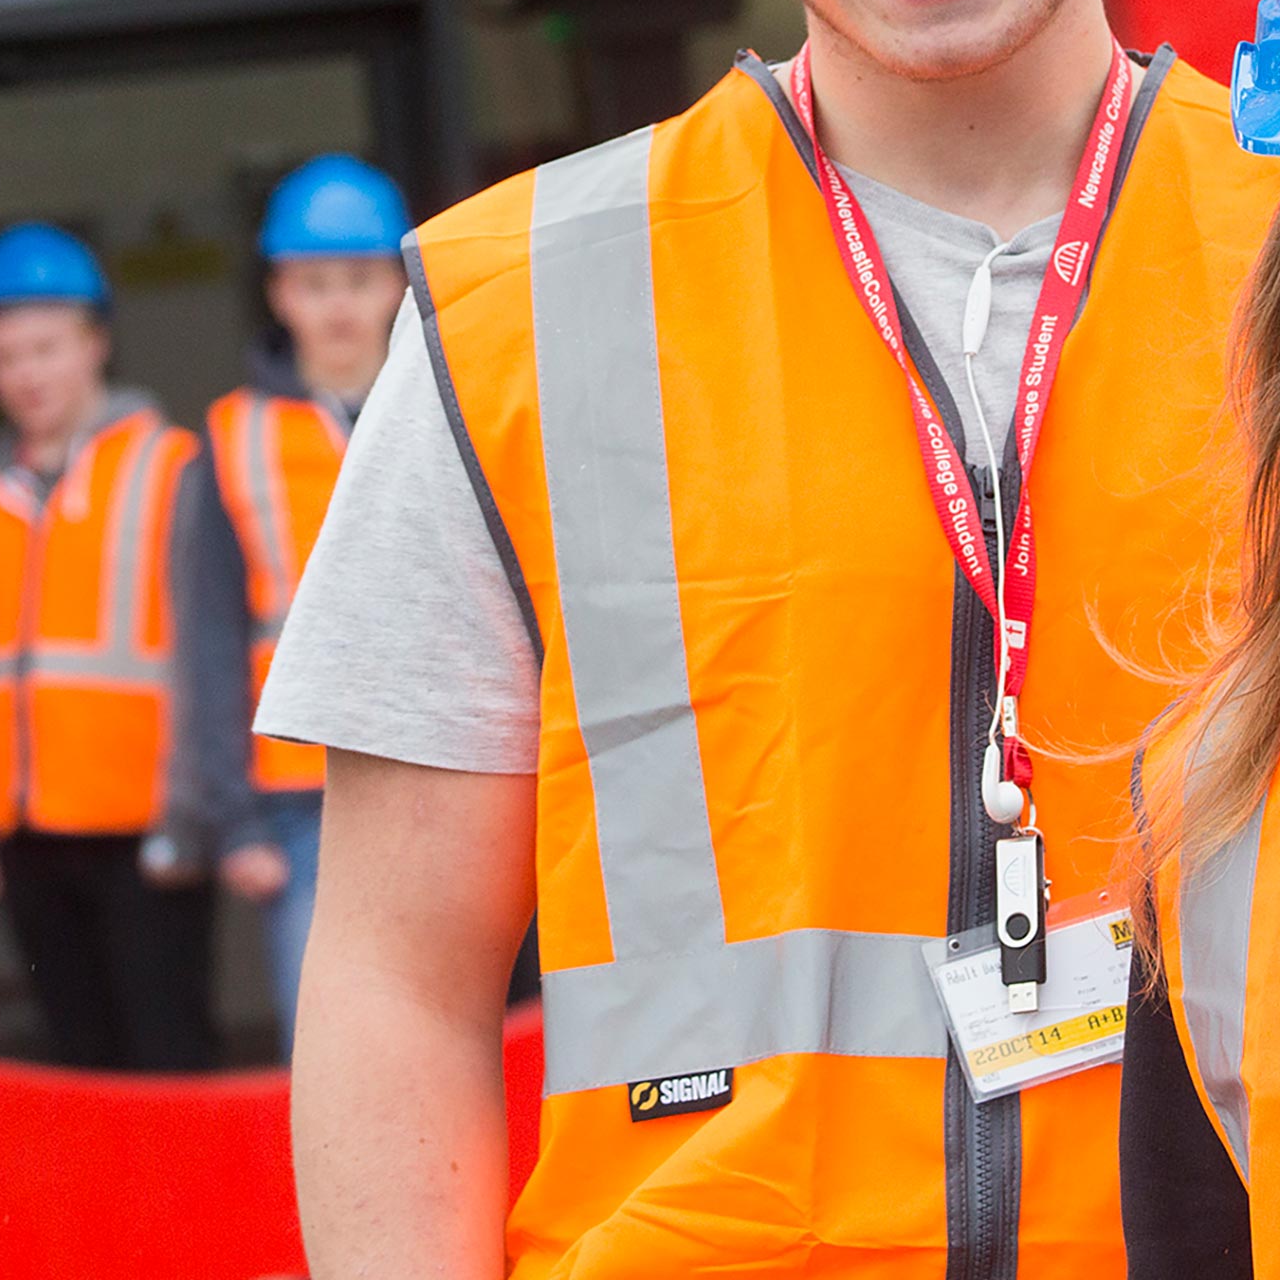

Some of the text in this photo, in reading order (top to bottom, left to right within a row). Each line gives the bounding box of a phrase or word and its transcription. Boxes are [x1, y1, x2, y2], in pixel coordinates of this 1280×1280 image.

[1078, 121, 1115, 208] Newcastle
[1025, 314, 1058, 386] Student
[927, 422, 983, 577] College Student
[1014, 532, 1031, 576] Join
[660, 1070, 730, 1105] SIGNAL
